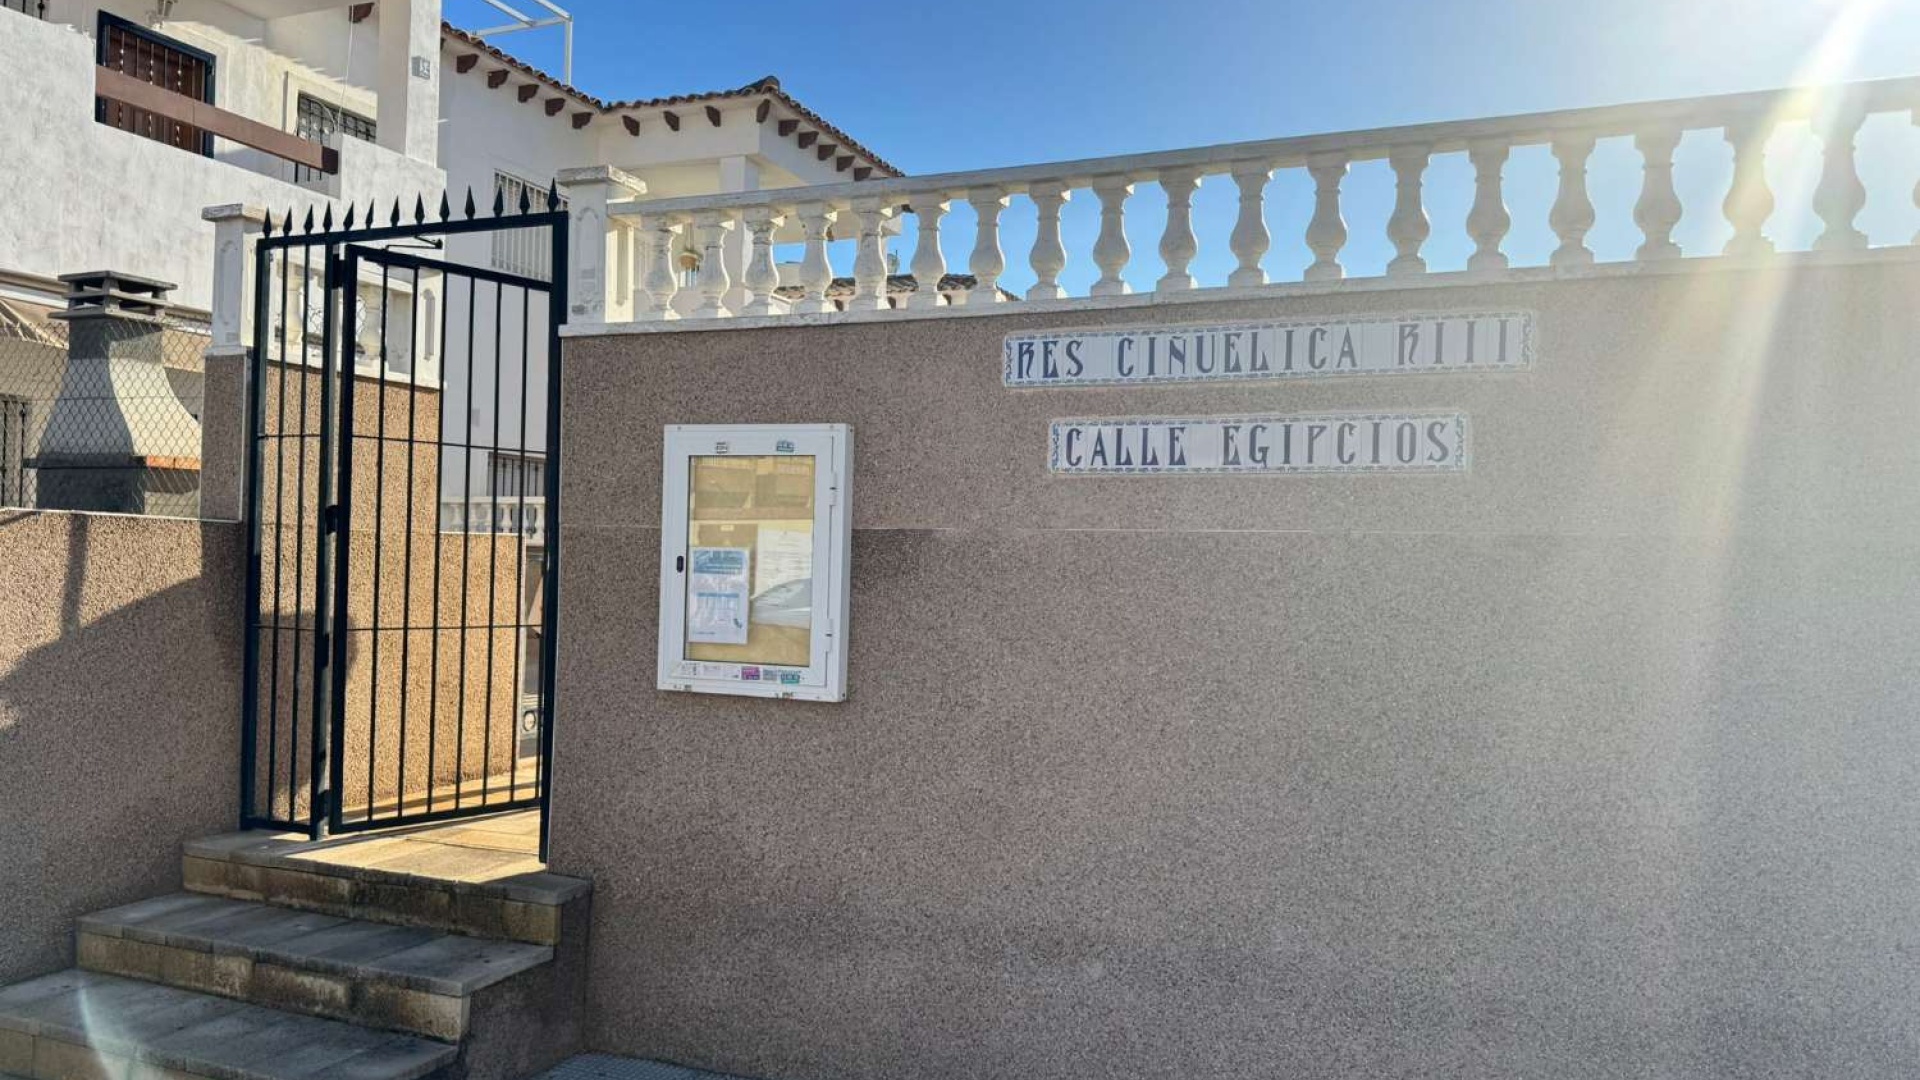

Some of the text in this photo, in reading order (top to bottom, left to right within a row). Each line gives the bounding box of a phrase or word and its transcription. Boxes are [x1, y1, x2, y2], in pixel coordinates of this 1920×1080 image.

[1017, 318, 1510, 379] RES CIÑUELICA RIII
[1065, 421, 1450, 468] CALLE EGIPCIOS
